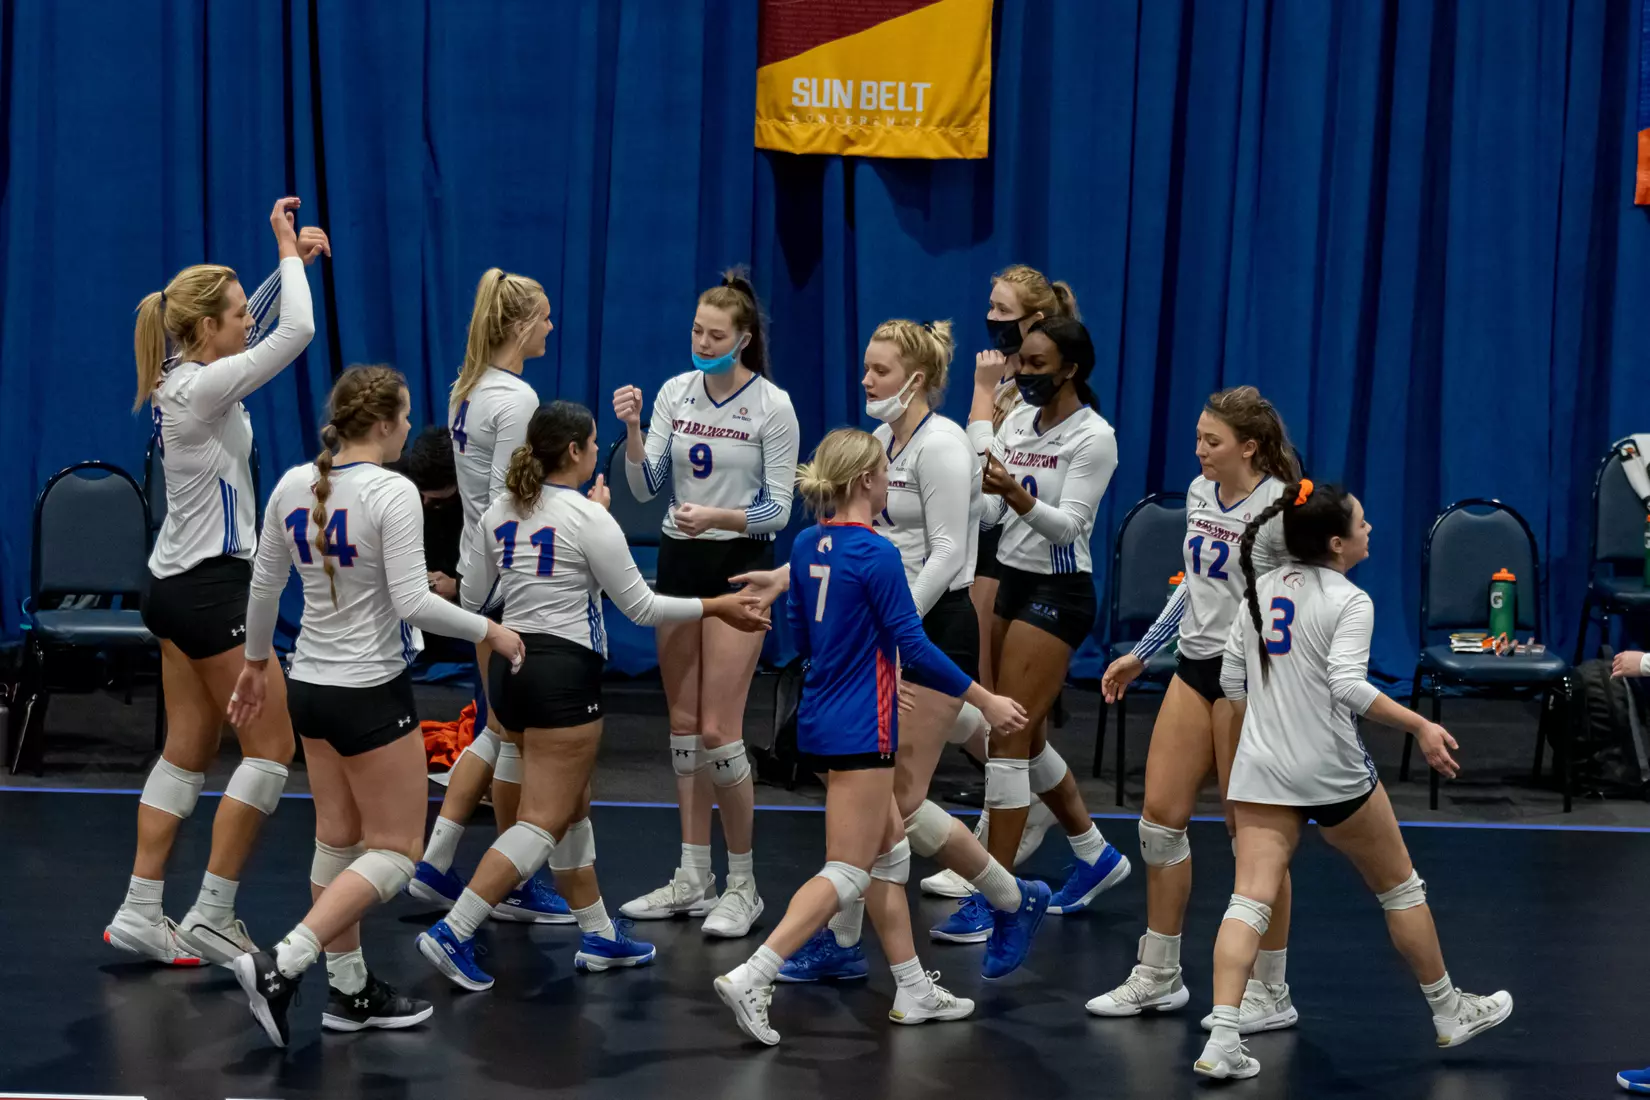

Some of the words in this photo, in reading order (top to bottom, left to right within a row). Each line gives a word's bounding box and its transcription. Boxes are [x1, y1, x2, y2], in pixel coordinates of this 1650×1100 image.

[792, 77, 852, 109] SUN
[859, 80, 931, 112] BELT
[688, 442, 713, 480] 9
[284, 507, 359, 567] 14
[493, 519, 556, 577] 11
[1188, 534, 1230, 581] 12
[809, 563, 831, 622] 7
[1265, 596, 1295, 656] 3
